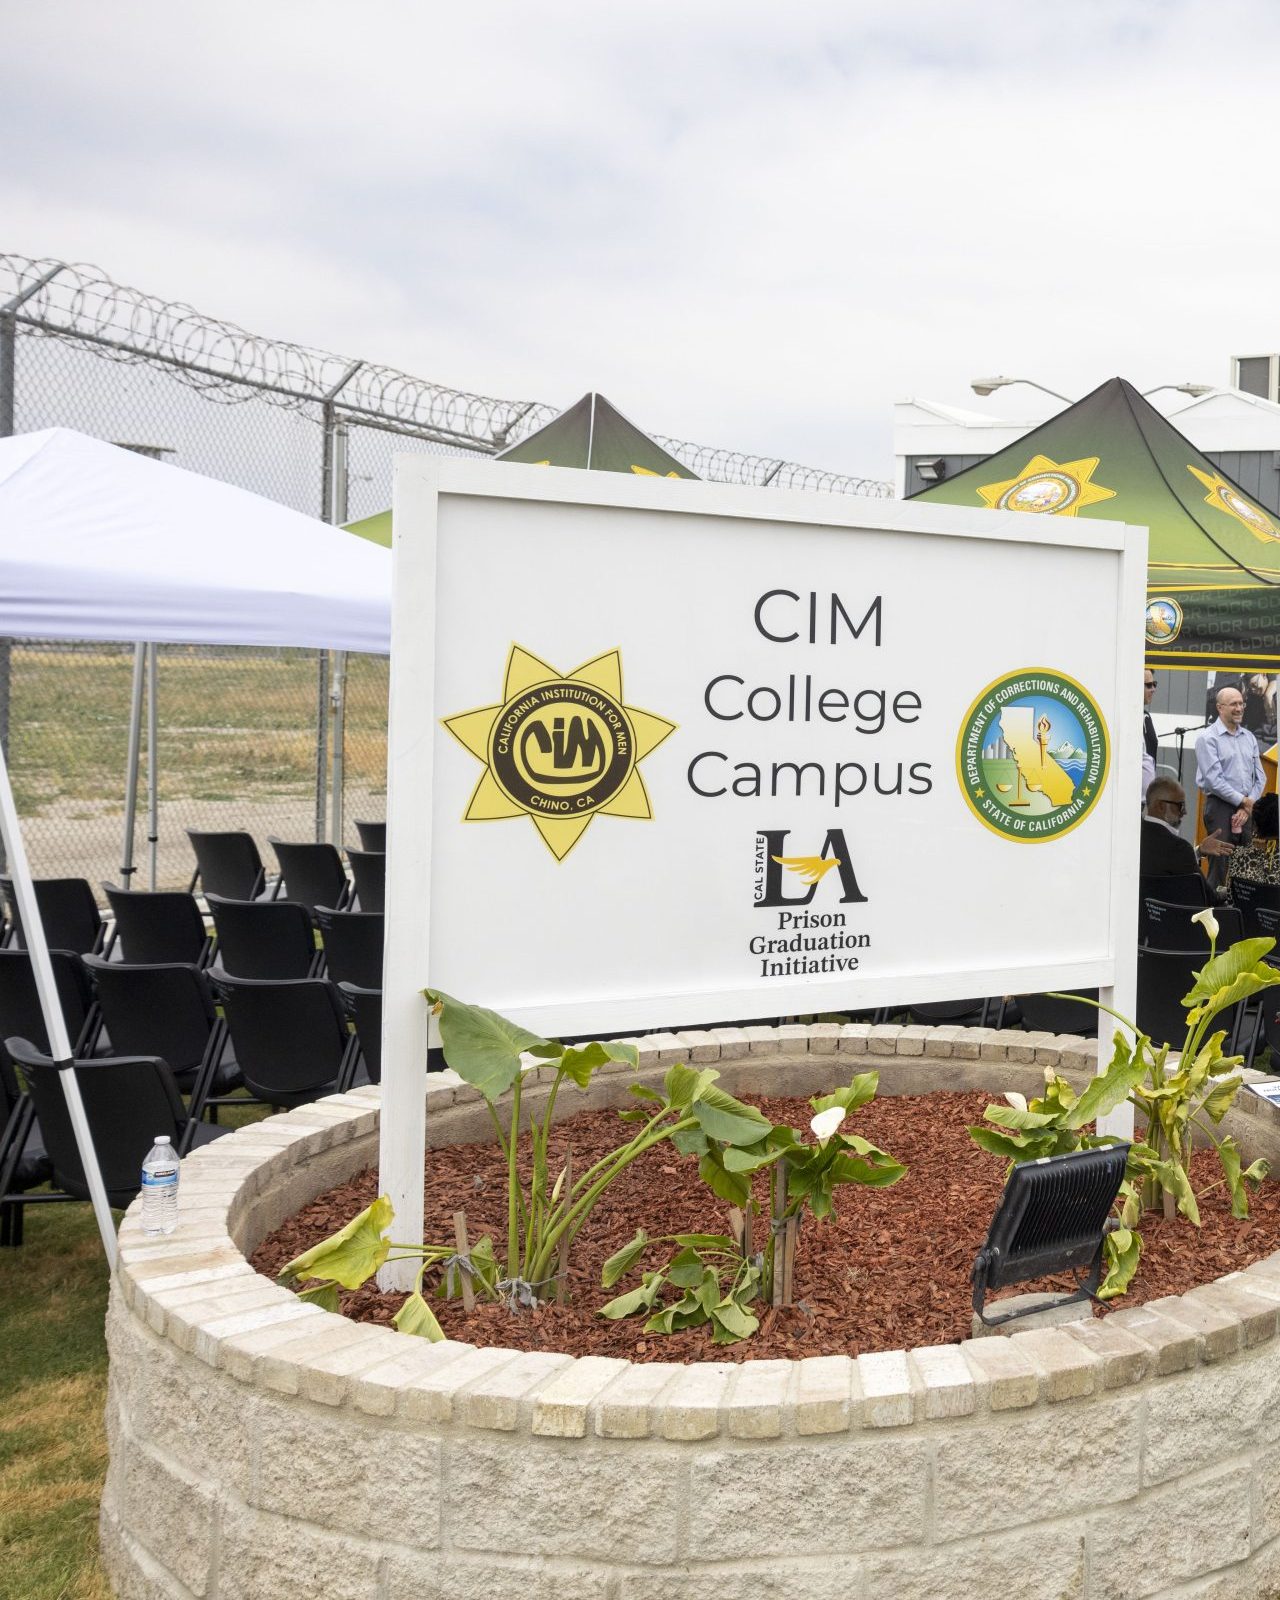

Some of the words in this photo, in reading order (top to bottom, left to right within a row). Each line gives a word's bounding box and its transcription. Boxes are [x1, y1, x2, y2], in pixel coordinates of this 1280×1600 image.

[754, 589, 882, 646] CIM
[499, 697, 540, 754] CALIFORNIA
[541, 689, 606, 711] INSTITUTION
[605, 710, 621, 729] FOR
[616, 732, 627, 755] MEN
[704, 675, 922, 734] College
[967, 711, 988, 785] DEPARTMENT
[984, 699, 996, 714] OF
[995, 680, 1060, 703] CORRECTIONS
[1060, 688, 1081, 706] AND
[1076, 702, 1101, 784] REHABILITATION
[688, 752, 933, 807] Campus
[531, 796, 573, 810] CHINO,
[577, 796, 594, 807] CA
[983, 799, 1012, 826] STATE
[1014, 819, 1026, 831] OF
[1029, 799, 1085, 831] CALIFORNIA
[754, 829, 868, 907] LA
[755, 837, 764, 872] STATE
[754, 877, 763, 900] CAL
[778, 910, 846, 930] Prison
[750, 931, 871, 954] Graduation
[761, 954, 859, 977] Initiative
